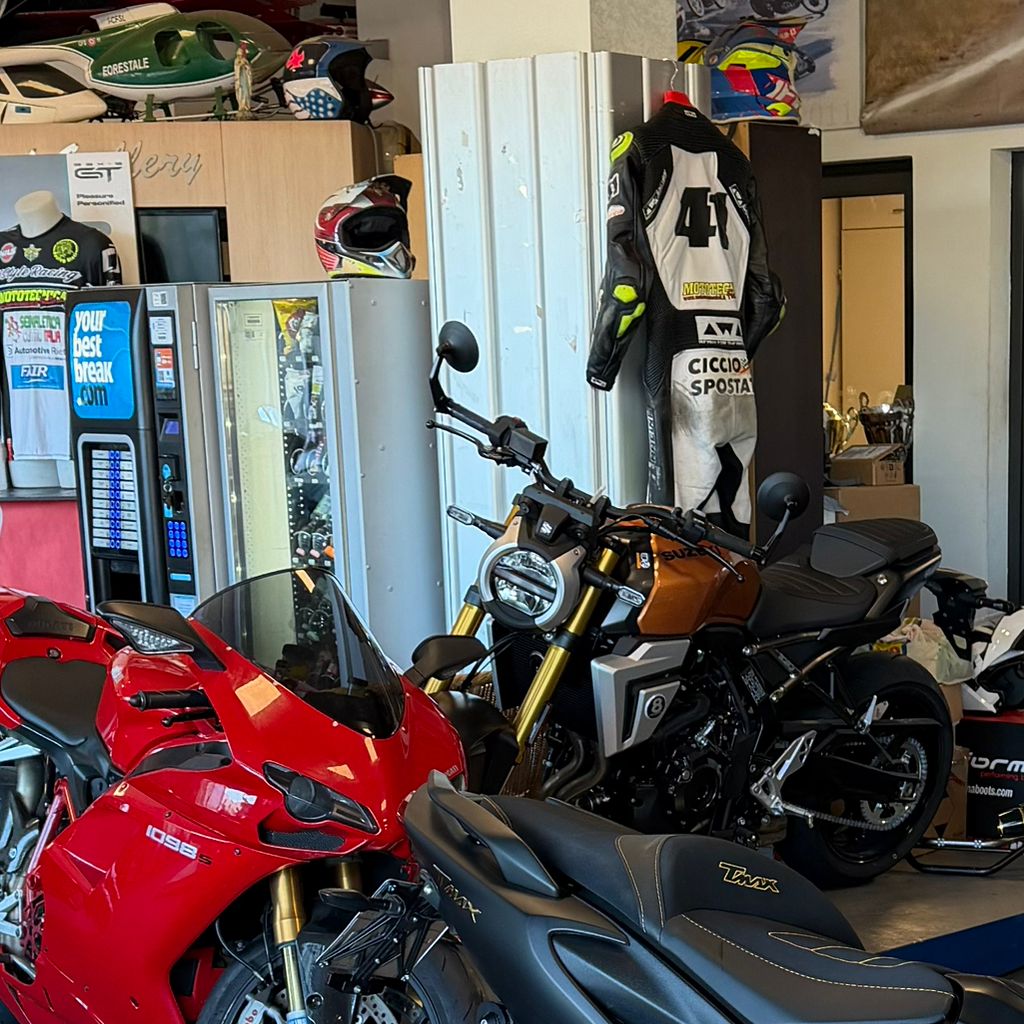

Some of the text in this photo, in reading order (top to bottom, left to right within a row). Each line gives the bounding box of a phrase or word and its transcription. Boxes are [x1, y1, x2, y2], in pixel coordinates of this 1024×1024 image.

[102, 57, 150, 78] FORESTALE
[74, 166, 123, 182] GT
[675, 187, 729, 250] 41
[31, 265, 82, 283] Racing
[74, 310, 107, 332] your
[14, 347, 50, 355] Automotive
[73, 333, 103, 357] best
[73, 358, 114, 383] break
[688, 357, 741, 375] CICCIO
[76, 385, 108, 407] .com
[690, 378, 753, 396] SPOSTA
[146, 824, 198, 860] 1098
